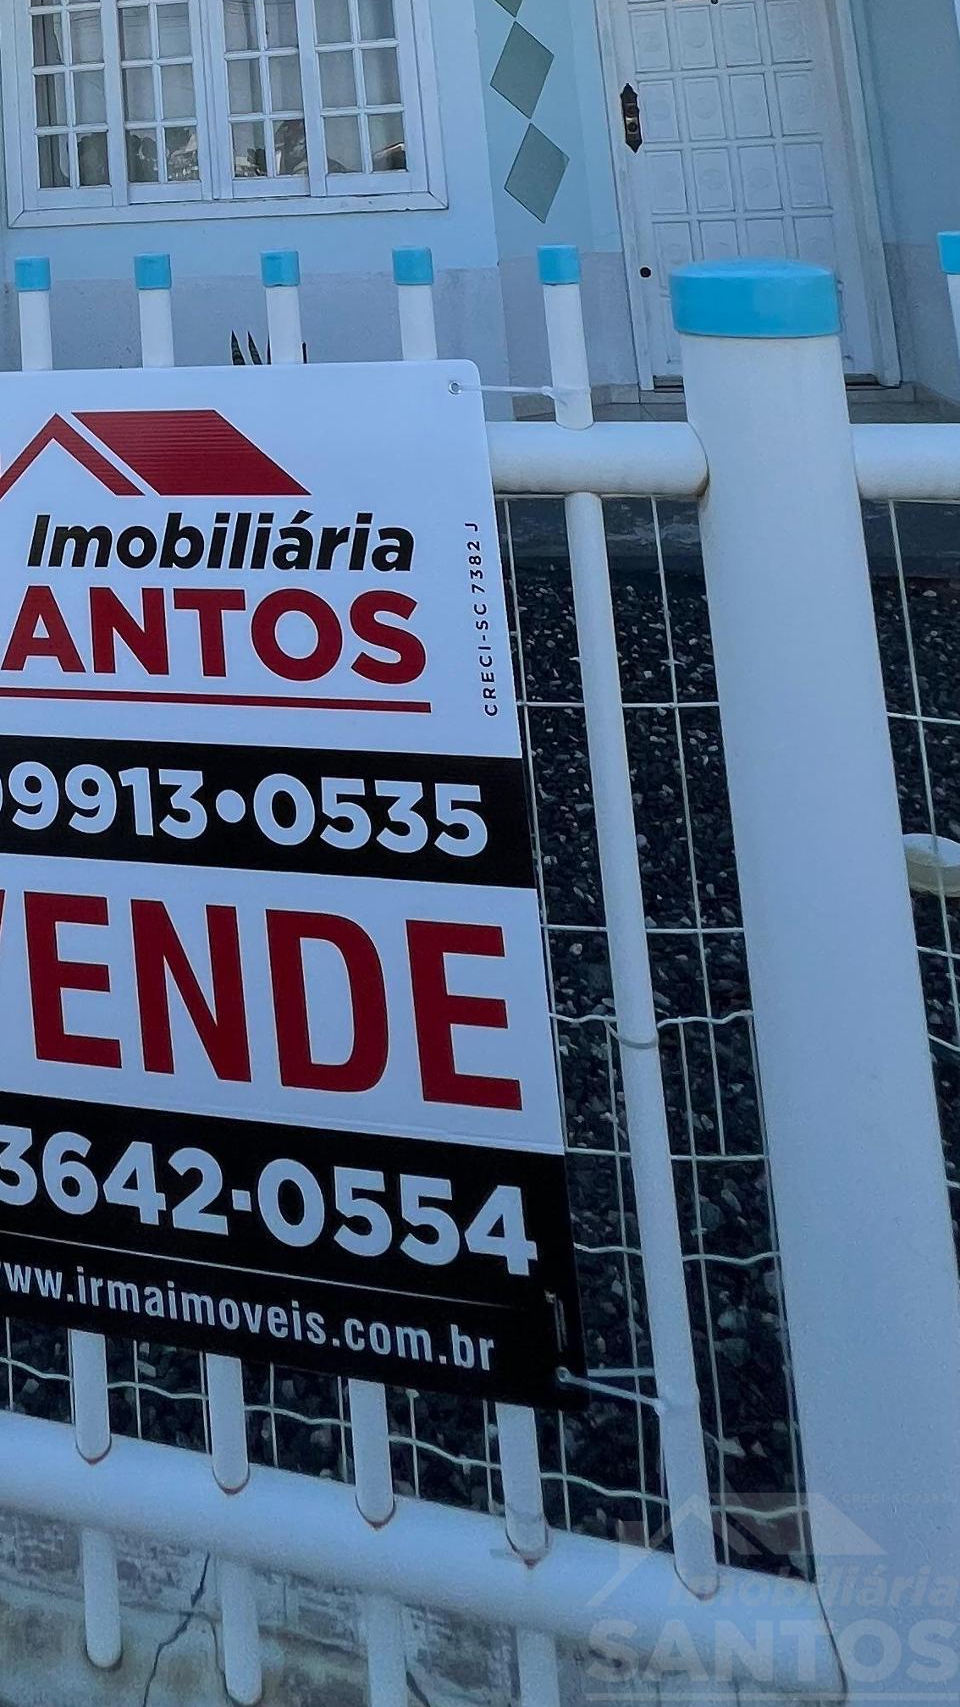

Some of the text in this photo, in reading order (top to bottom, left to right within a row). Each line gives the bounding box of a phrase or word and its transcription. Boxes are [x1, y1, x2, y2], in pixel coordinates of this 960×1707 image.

[26, 508, 416, 573] Imobiliária
[464, 522, 499, 717] CRECI-SC 7382 J
